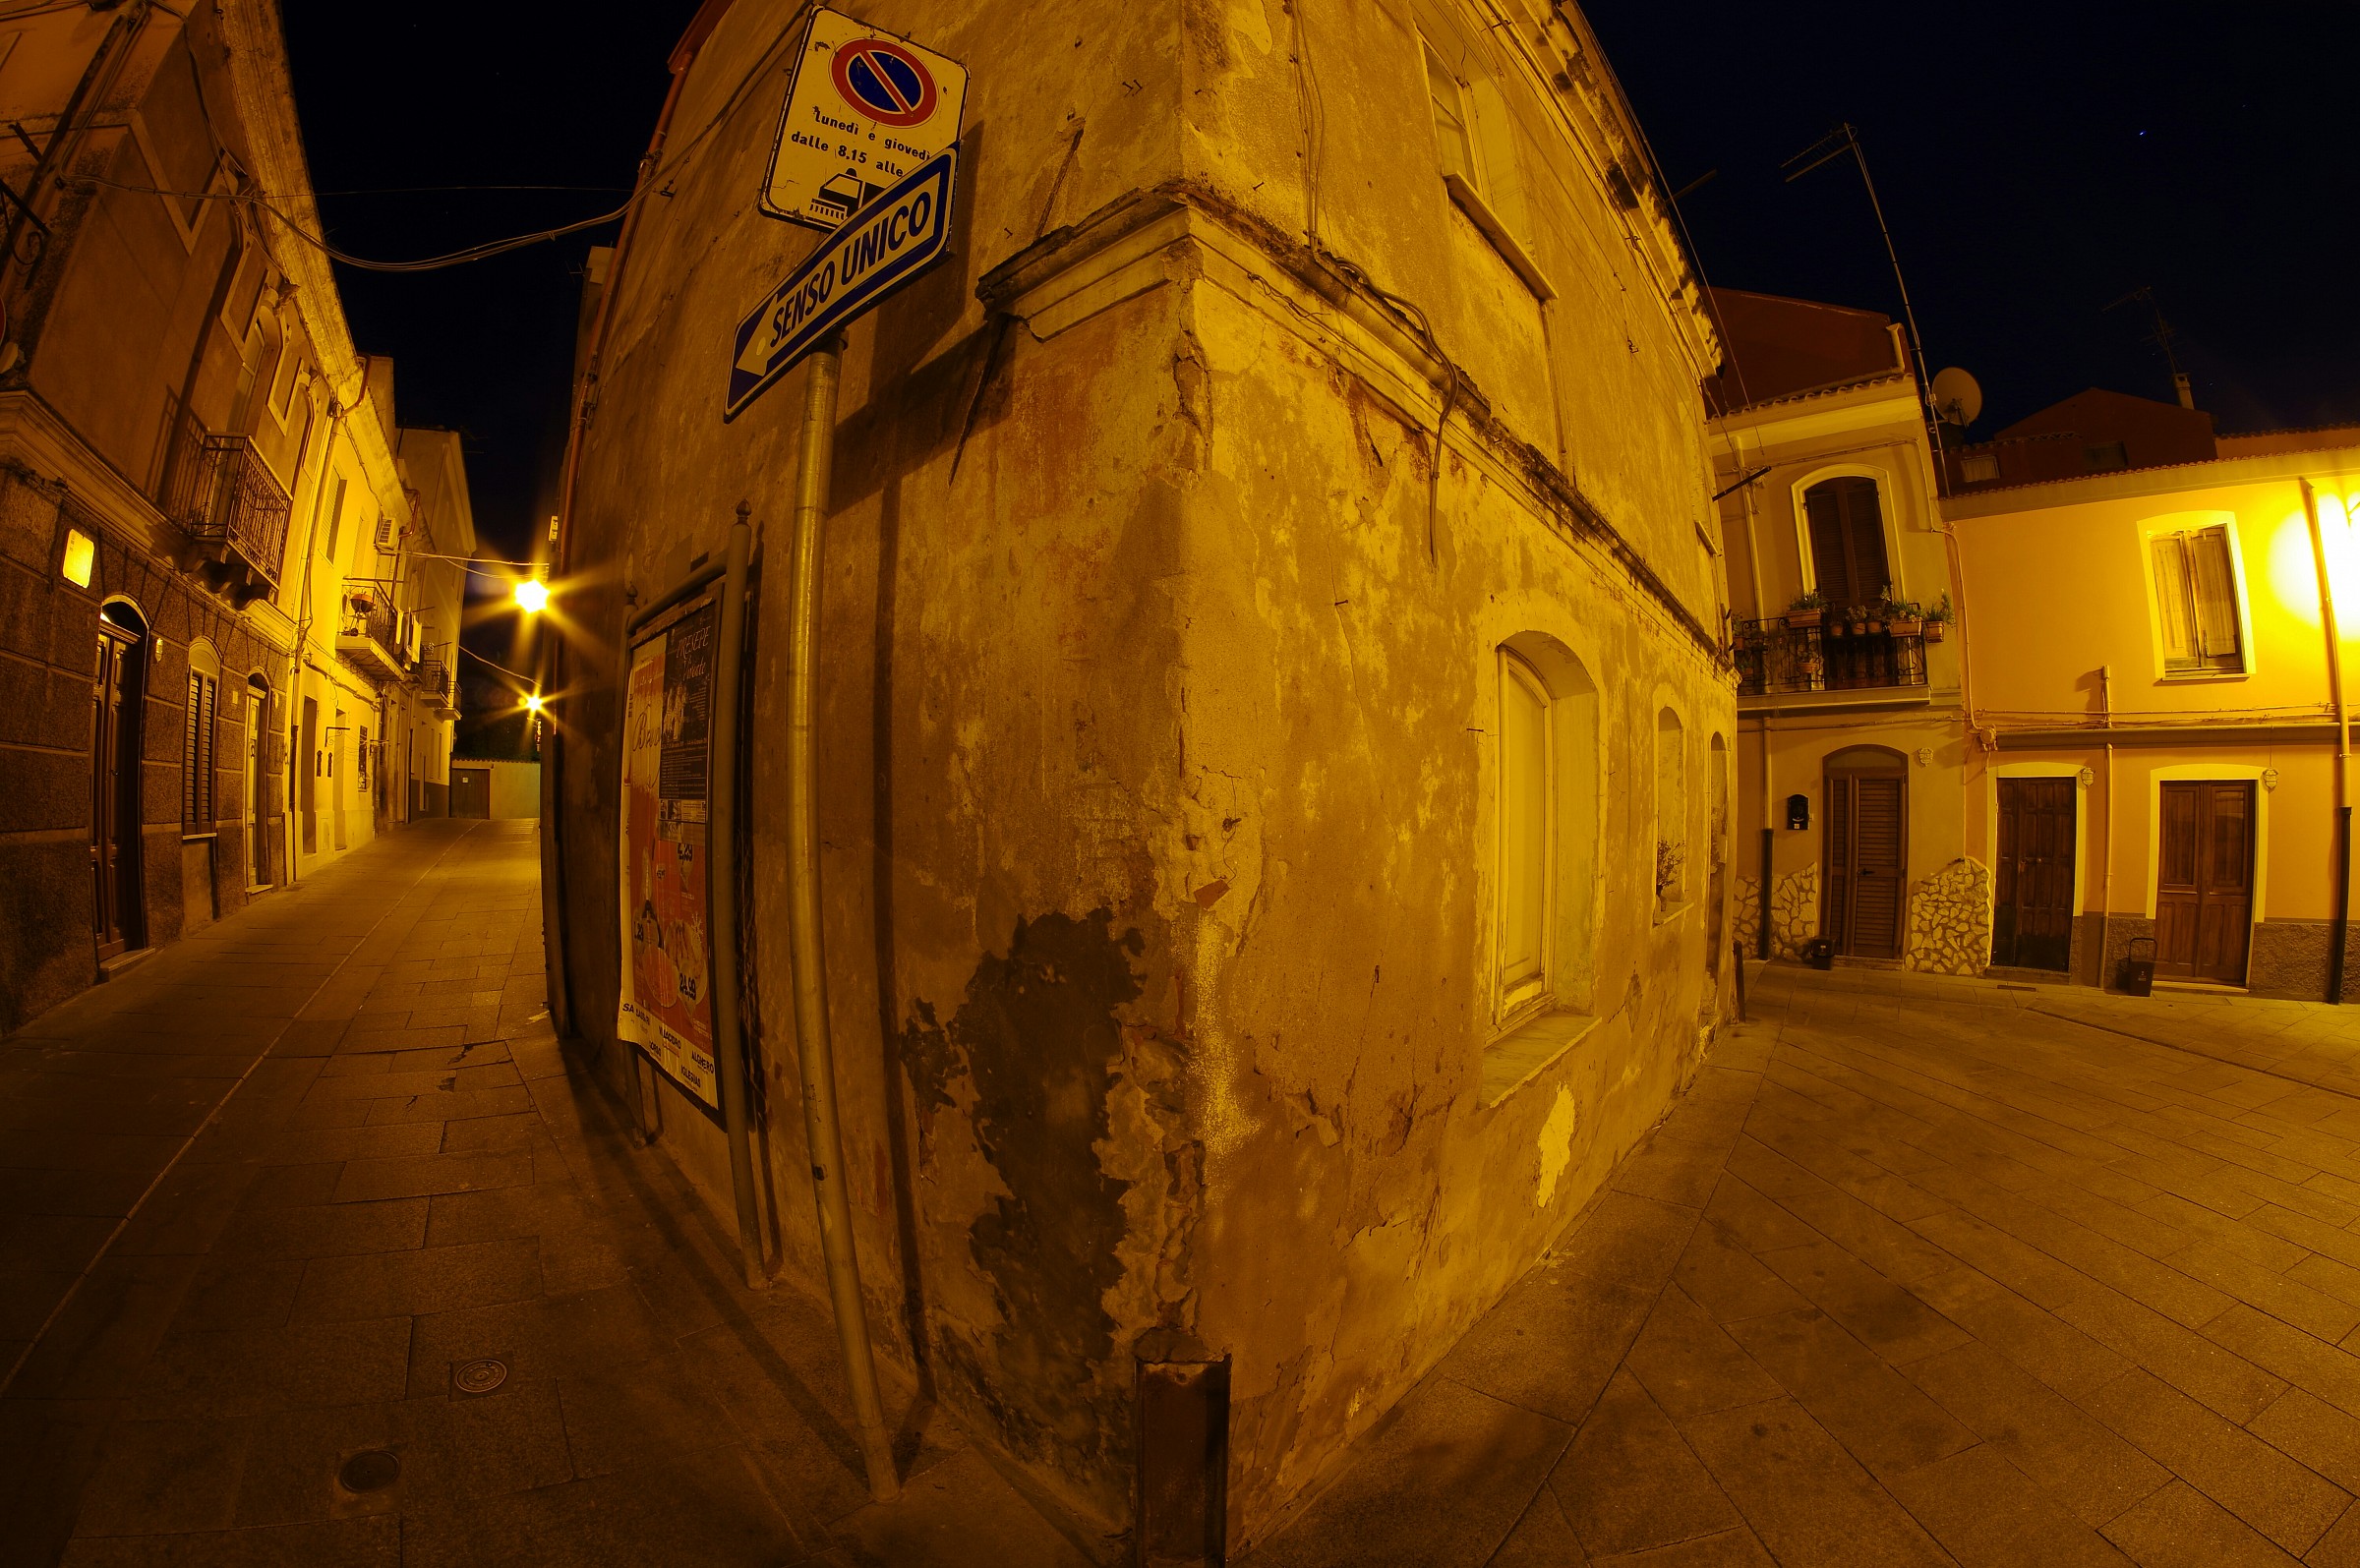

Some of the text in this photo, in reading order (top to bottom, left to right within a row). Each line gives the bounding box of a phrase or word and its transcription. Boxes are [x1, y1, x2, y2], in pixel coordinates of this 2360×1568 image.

[791, 131, 829, 151] dalle
[875, 160, 904, 178] alle
[814, 110, 930, 161] lunedì e giovedì
[770, 191, 931, 348] SENSO UNICO
